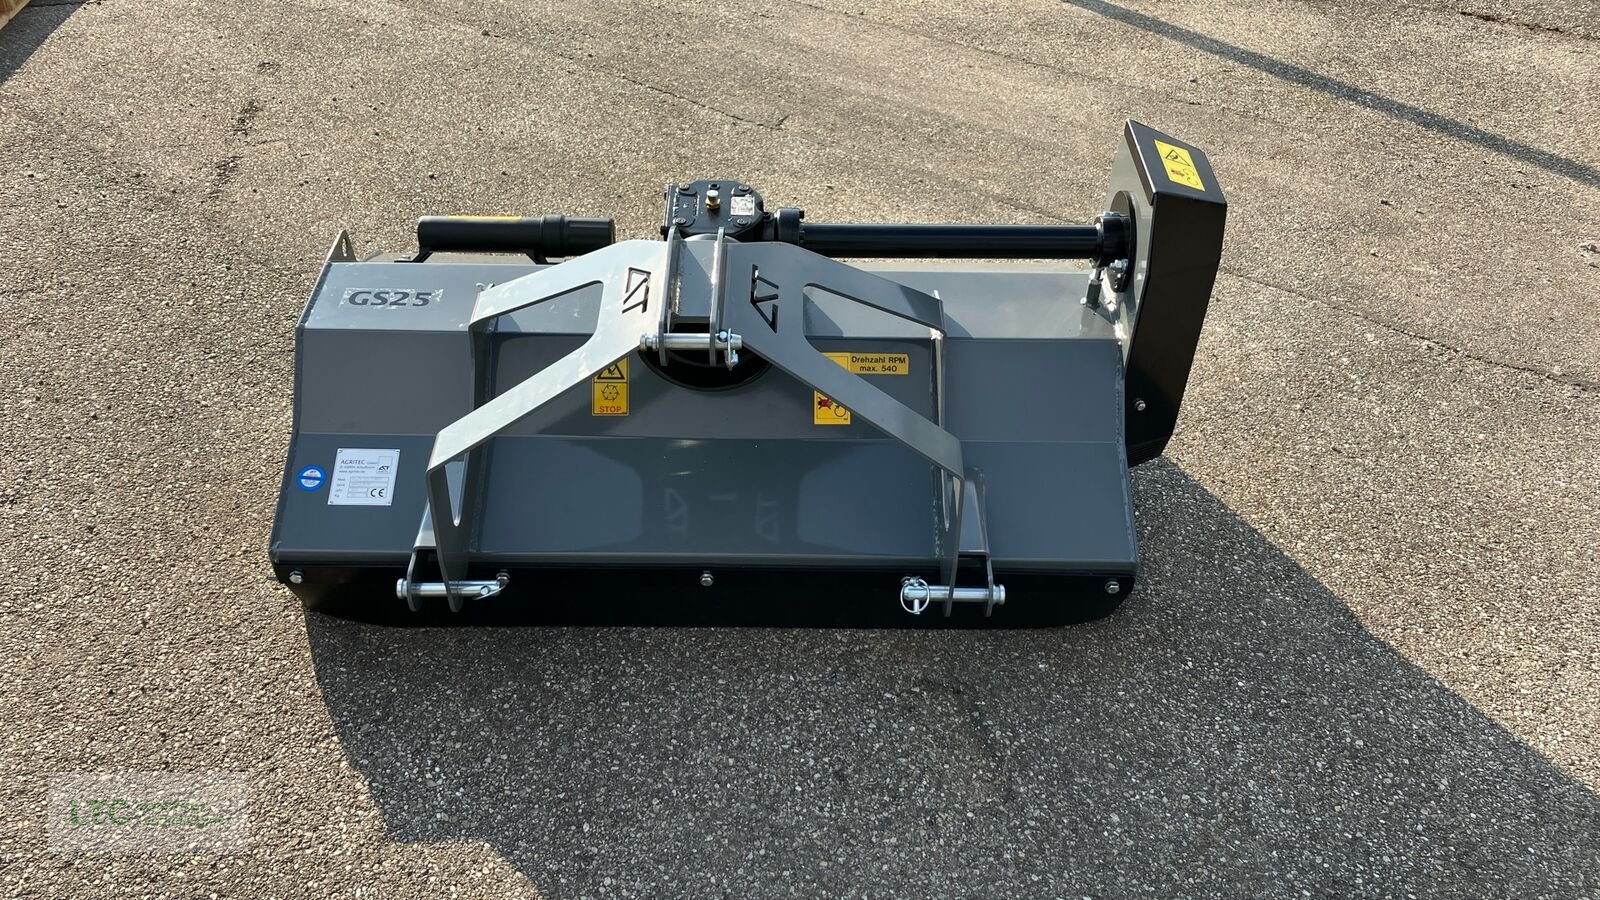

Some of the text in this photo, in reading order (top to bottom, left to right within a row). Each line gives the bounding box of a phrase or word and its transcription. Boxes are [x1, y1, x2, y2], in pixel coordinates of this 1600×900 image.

[348, 291, 432, 307] GS25
[851, 356, 906, 364] Drehzahl RPM
[859, 365, 898, 373] max. 540
[599, 405, 622, 413] STOP
